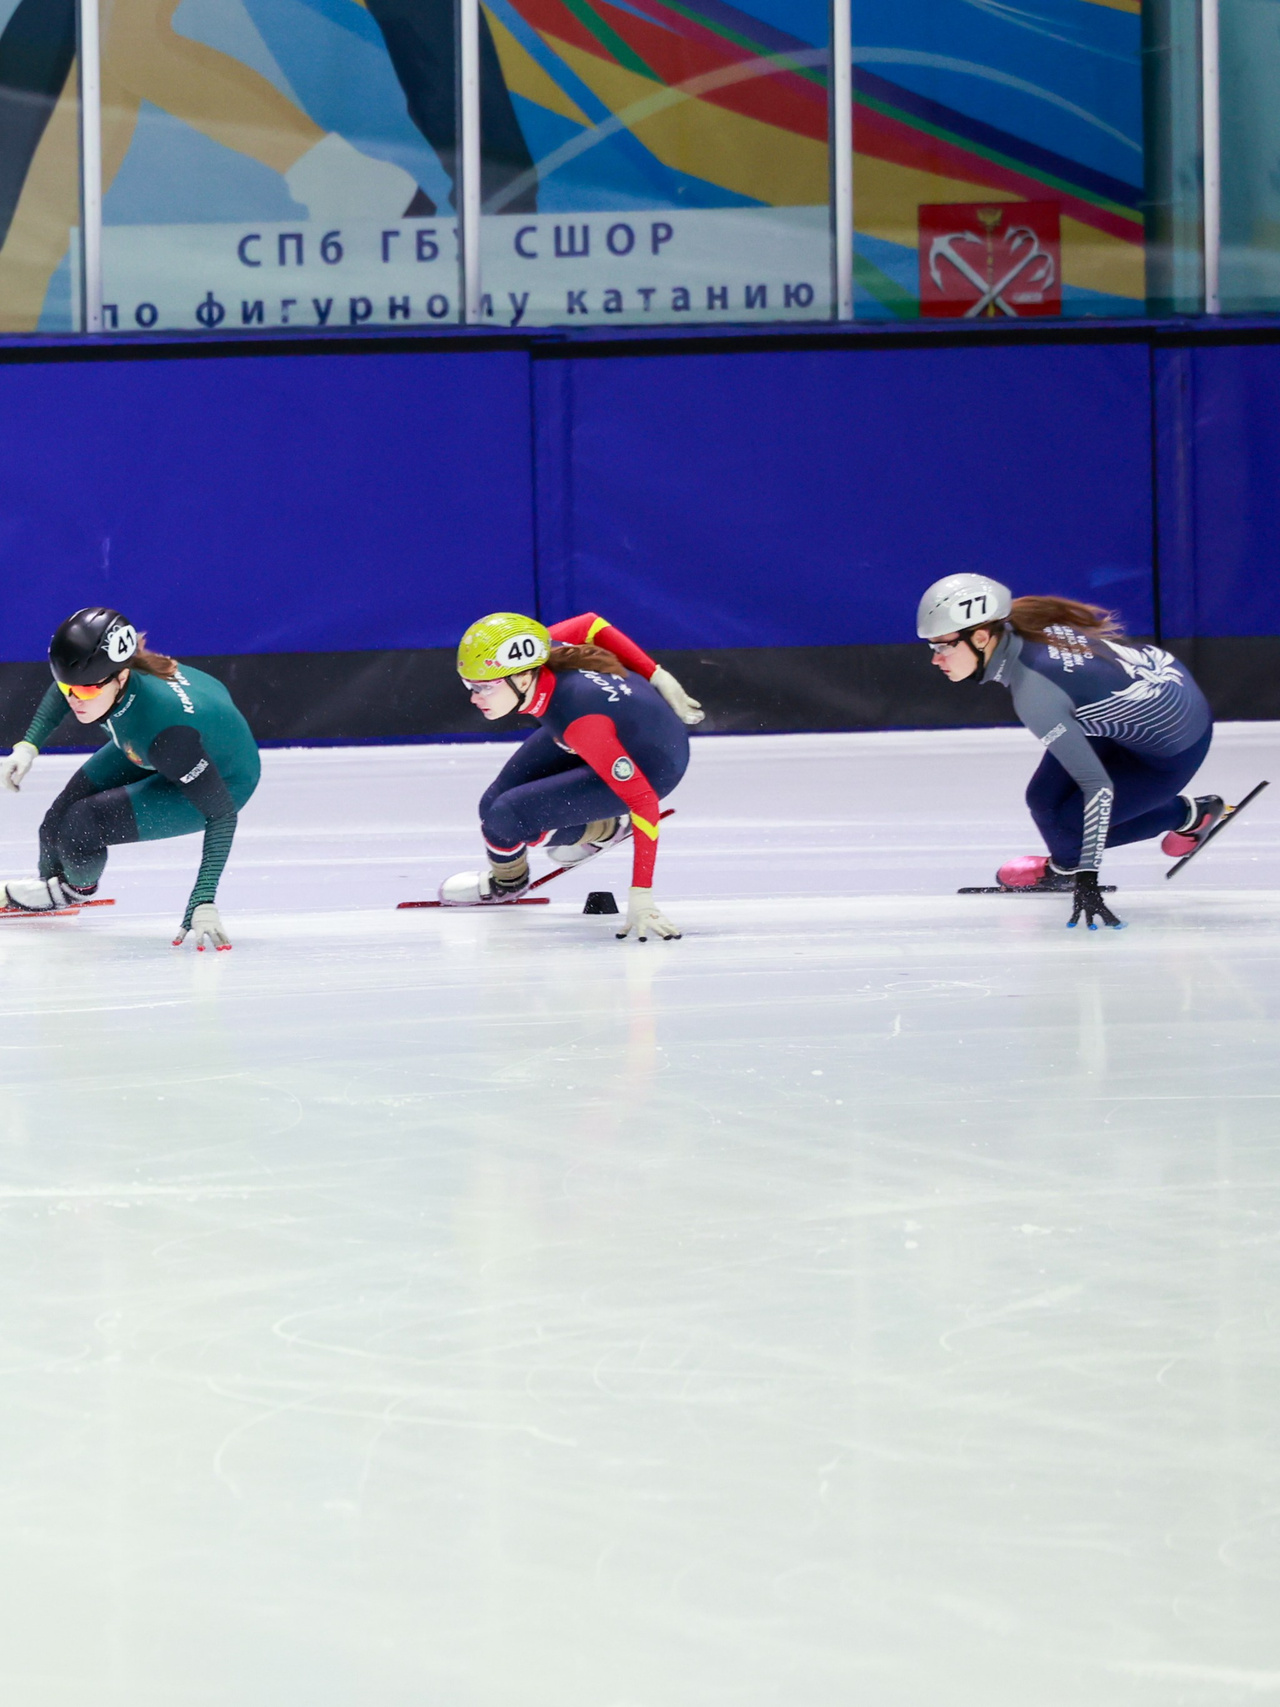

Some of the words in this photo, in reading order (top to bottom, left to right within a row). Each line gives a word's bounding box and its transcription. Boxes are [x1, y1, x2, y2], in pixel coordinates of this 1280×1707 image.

[237, 230, 344, 267] СПб
[381, 228, 461, 263] ГБ
[514, 221, 674, 259] СШОР
[102, 302, 159, 328] по
[566, 282, 814, 315] катанию
[958, 595, 987, 619] 77
[118, 629, 135, 655] 41
[508, 638, 535, 660] 40
